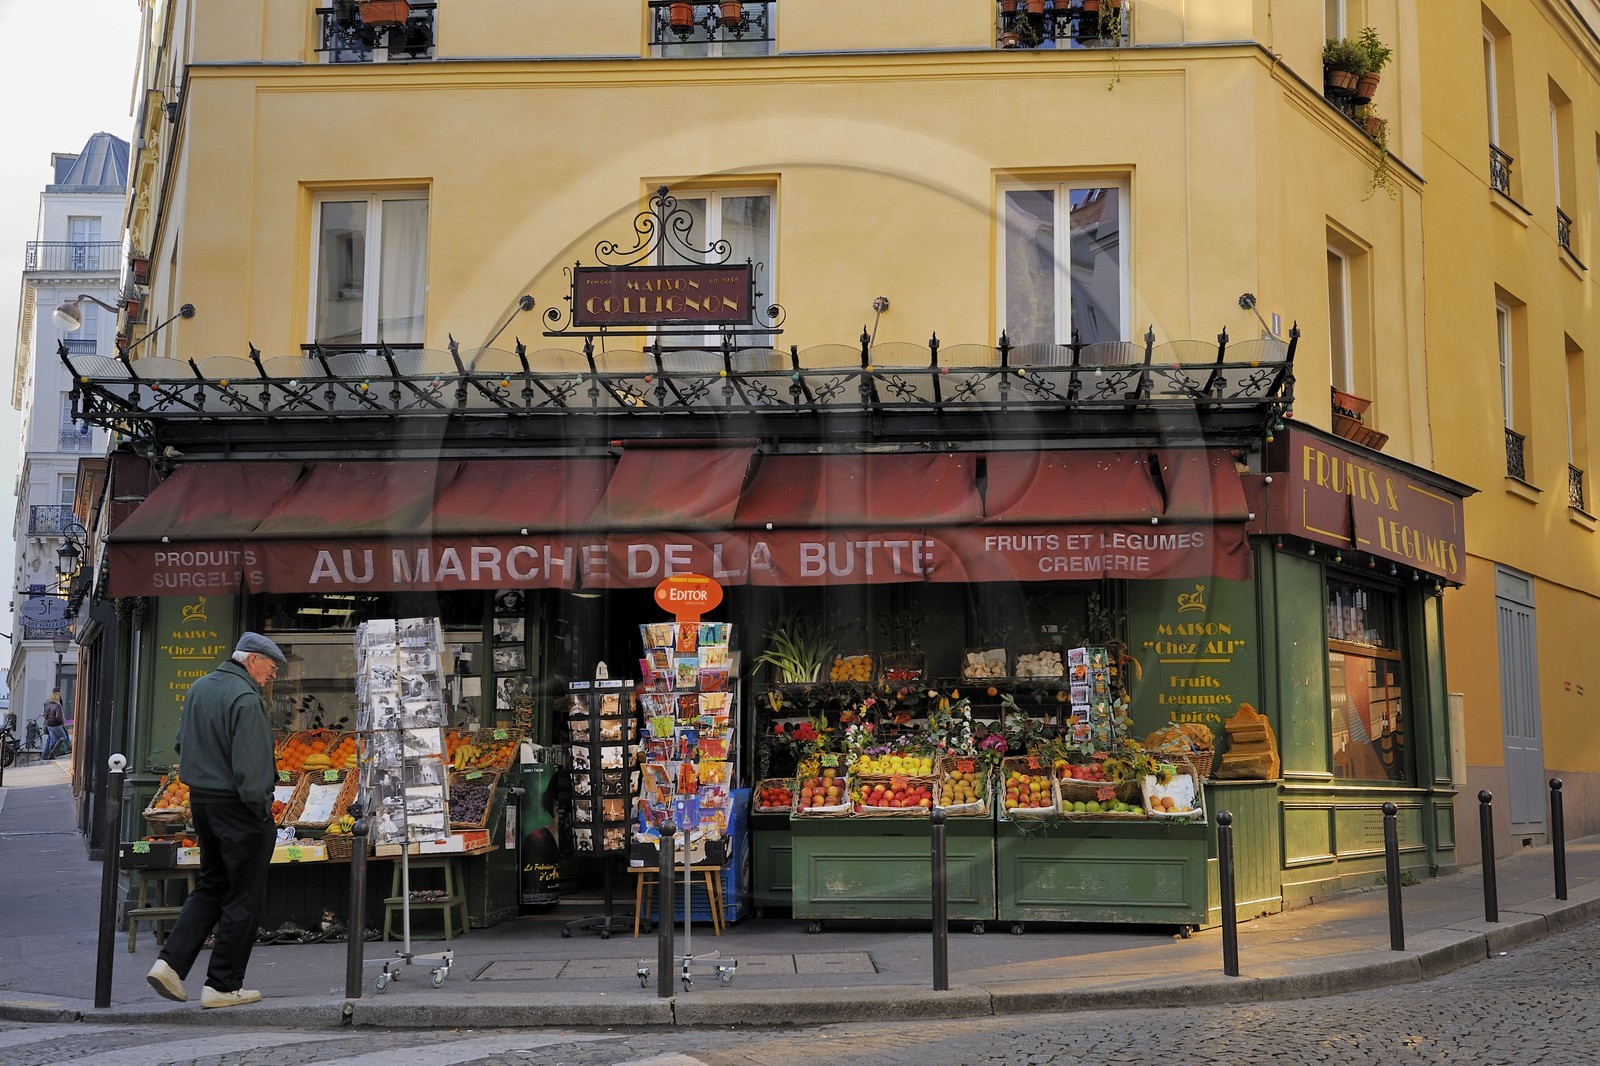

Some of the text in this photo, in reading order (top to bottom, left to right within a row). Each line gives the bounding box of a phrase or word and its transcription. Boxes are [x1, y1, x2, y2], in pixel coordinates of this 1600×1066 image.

[625, 278, 699, 291] MAISON
[586, 295, 739, 314] COLLIGNON
[1303, 445, 1399, 512] FRUITS &
[985, 531, 1205, 552] FRUITS ET LEGUMES
[1377, 516, 1458, 574] LEGUMES
[154, 551, 257, 567] PRODUITS
[308, 540, 935, 584] AU MARCHE DE LA BUTTE
[1038, 554, 1150, 573] CREMERIE
[38, 599, 54, 615] 3F
[171, 630, 219, 639] MAISON
[1156, 622, 1232, 636] MAISON
[1170, 675, 1220, 688] Fruits
[1159, 693, 1232, 705] Legumes
